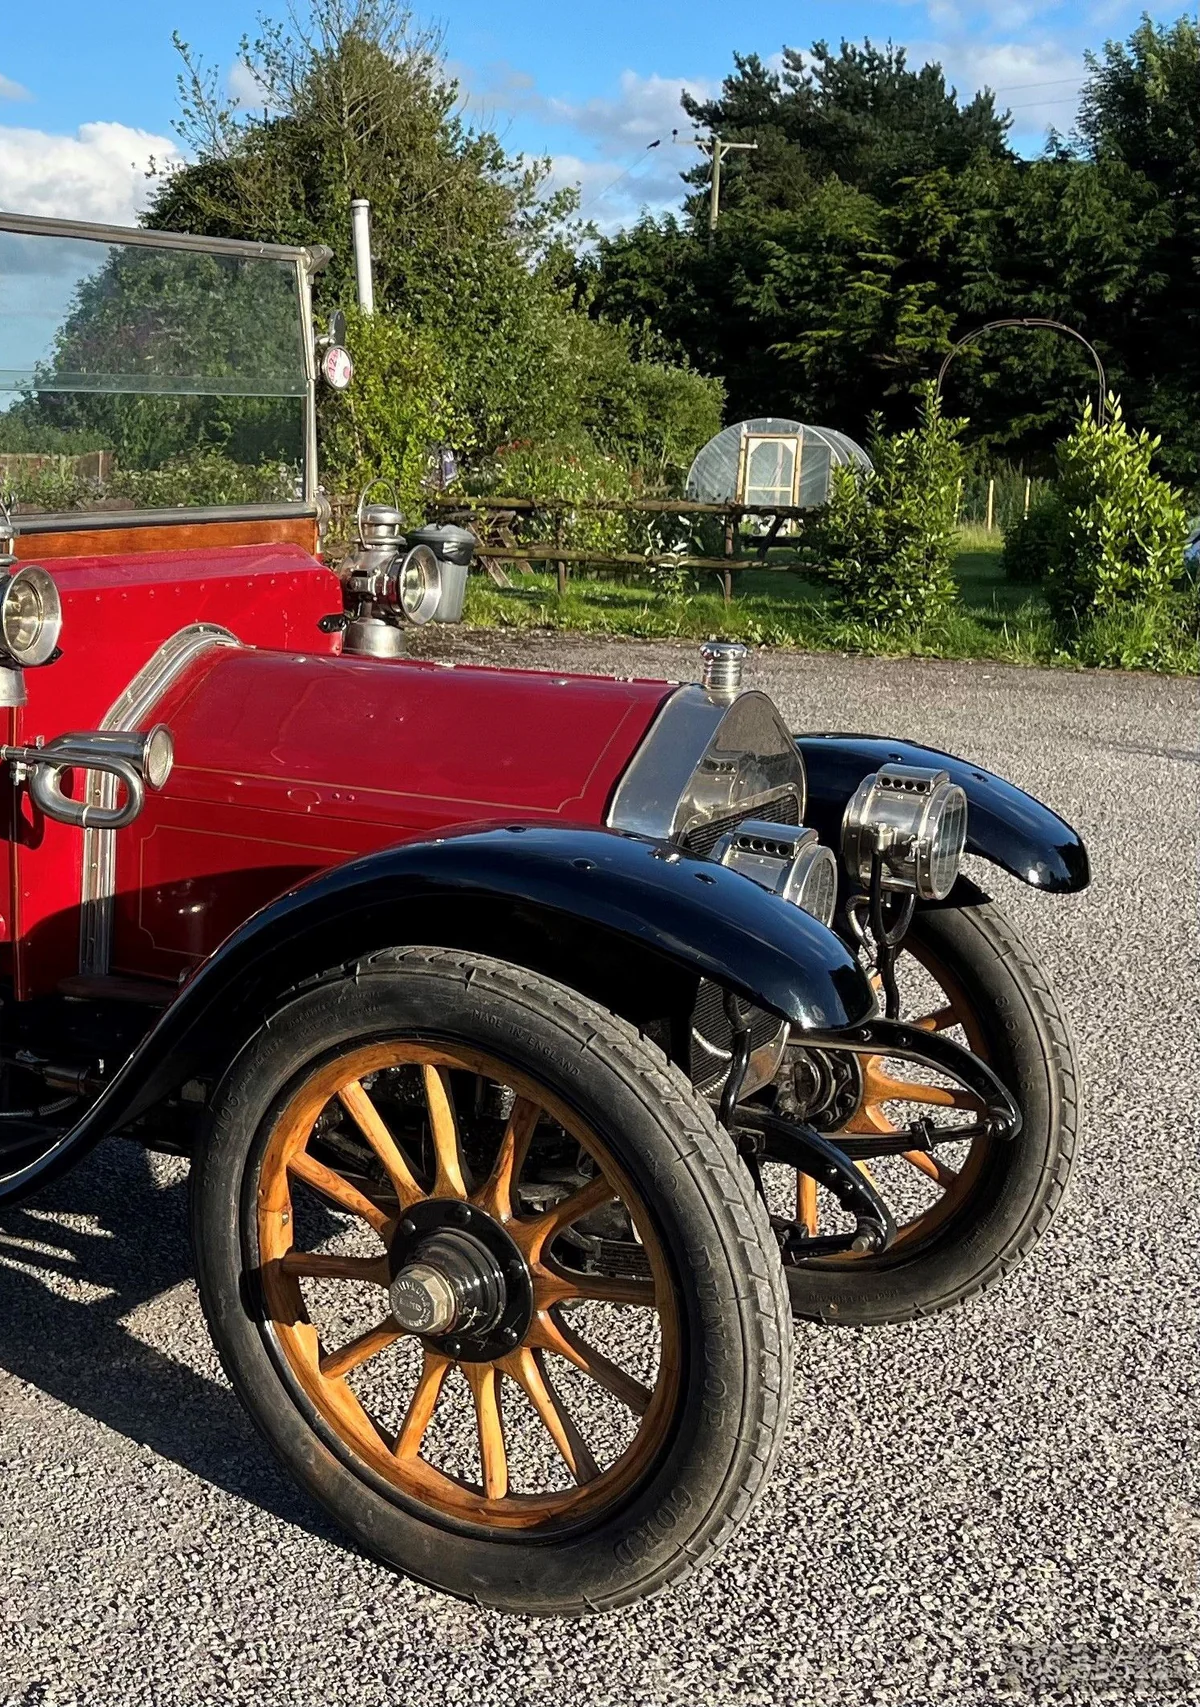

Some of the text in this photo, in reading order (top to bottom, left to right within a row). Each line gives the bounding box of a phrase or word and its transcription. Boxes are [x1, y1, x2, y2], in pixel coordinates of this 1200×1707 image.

[471, 1008, 502, 1029] MADE
[526, 1037, 581, 1077] ENGLAND
[688, 1245, 729, 1428] DUNLOP
[613, 1485, 692, 1566] CORD
